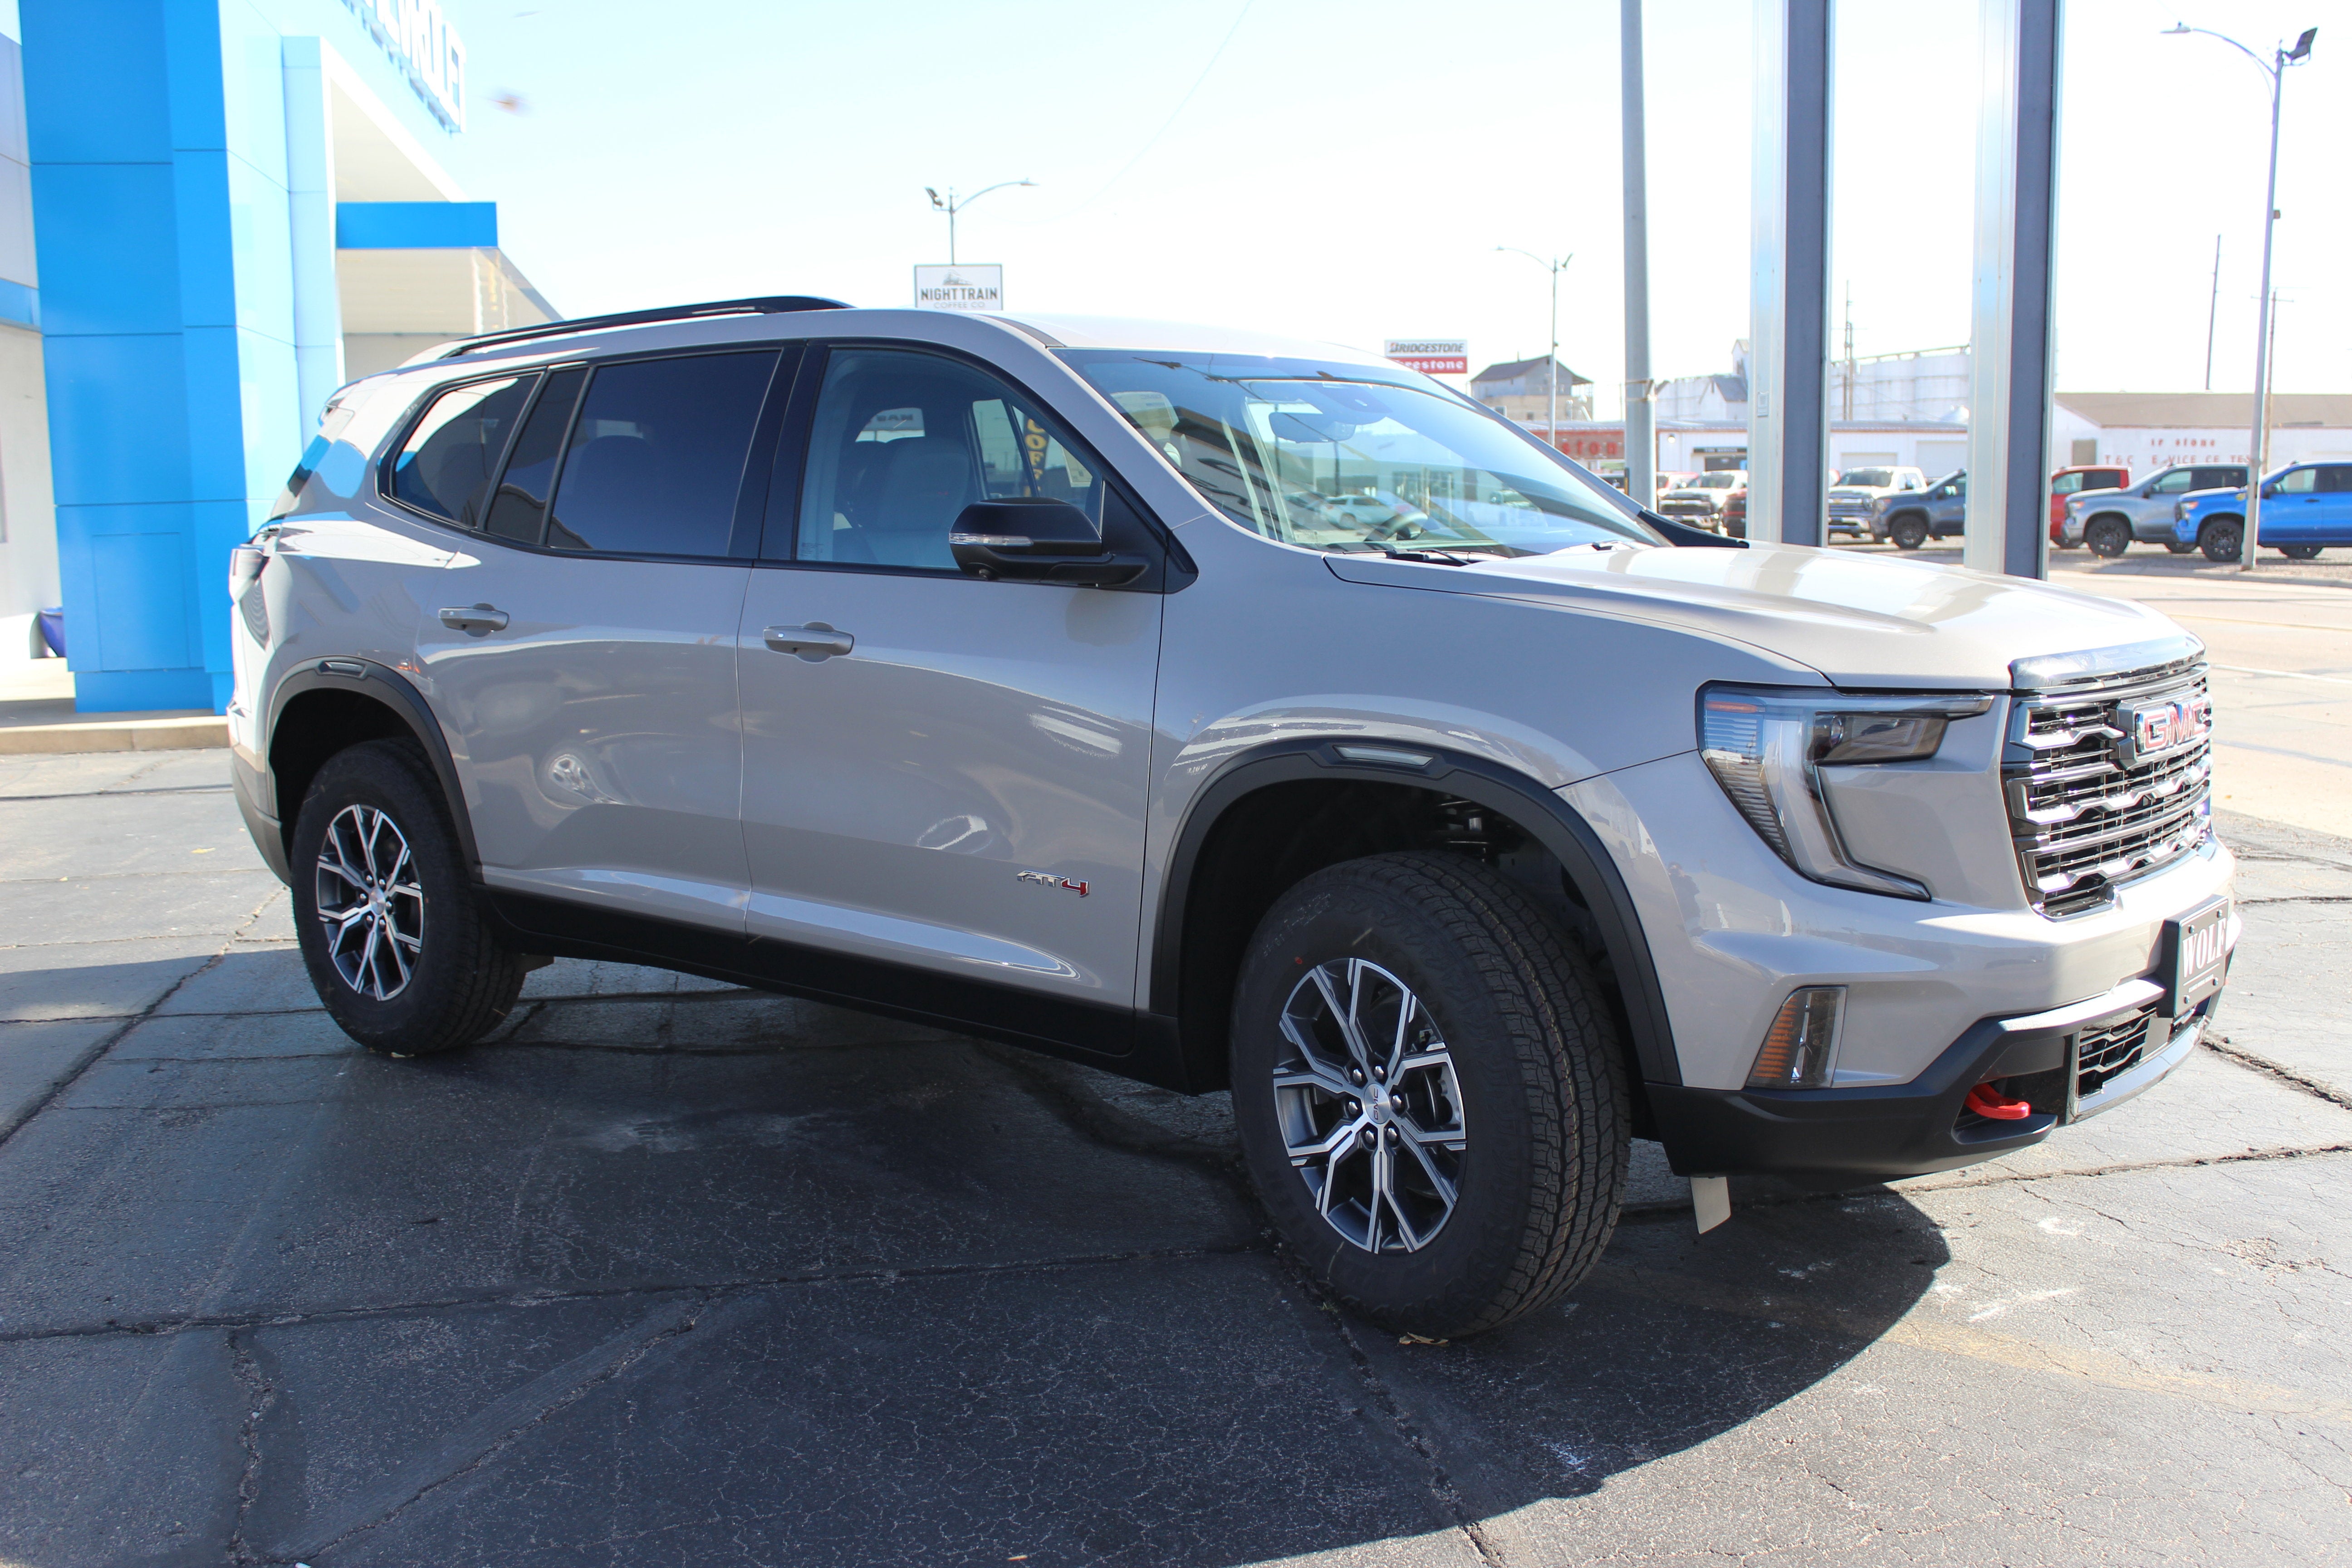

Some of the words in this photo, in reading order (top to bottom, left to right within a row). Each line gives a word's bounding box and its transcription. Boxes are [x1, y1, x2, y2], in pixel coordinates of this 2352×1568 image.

[921, 288, 958, 300] NIGHT
[960, 287, 998, 299] TRAIN
[1389, 343, 1464, 353] BRIDGESTONE
[2143, 701, 2207, 750] GMC
[1016, 869, 1089, 897] AT4
[2182, 917, 2226, 978] WOLF
